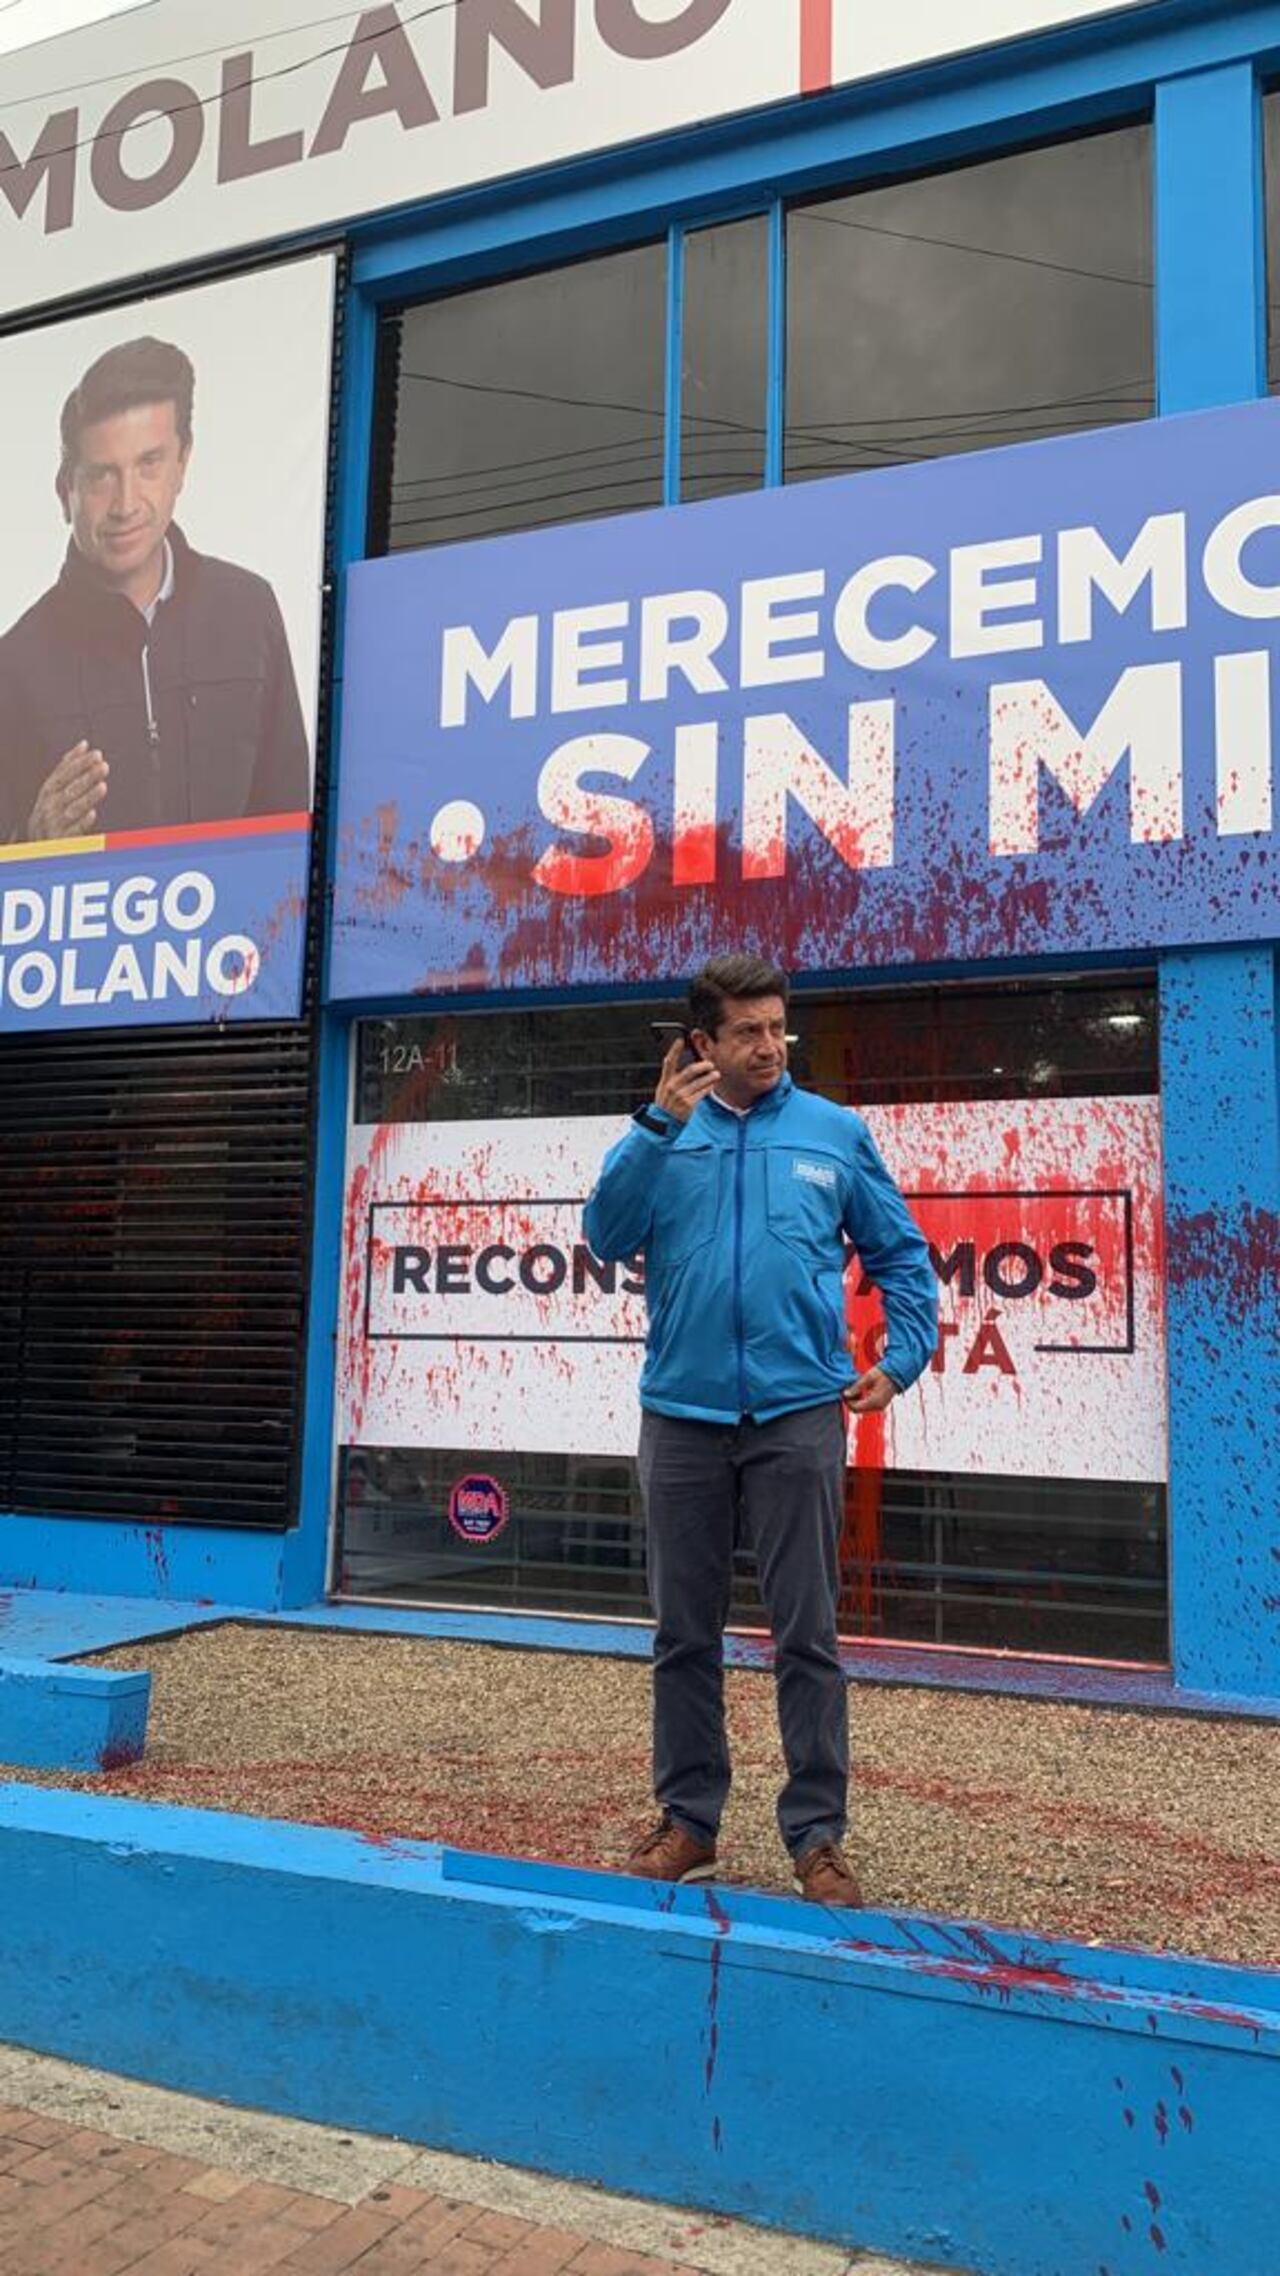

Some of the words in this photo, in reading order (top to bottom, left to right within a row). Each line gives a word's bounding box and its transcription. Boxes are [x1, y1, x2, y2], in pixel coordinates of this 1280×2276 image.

[440, 495, 1280, 728] MERECEMO
[531, 697, 895, 896] SIN
[989, 650, 1273, 857] MI
[1, 870, 216, 945] DIEGO
[0, 934, 261, 1009] OLANO
[379, 1040, 458, 1074] 12A-11
